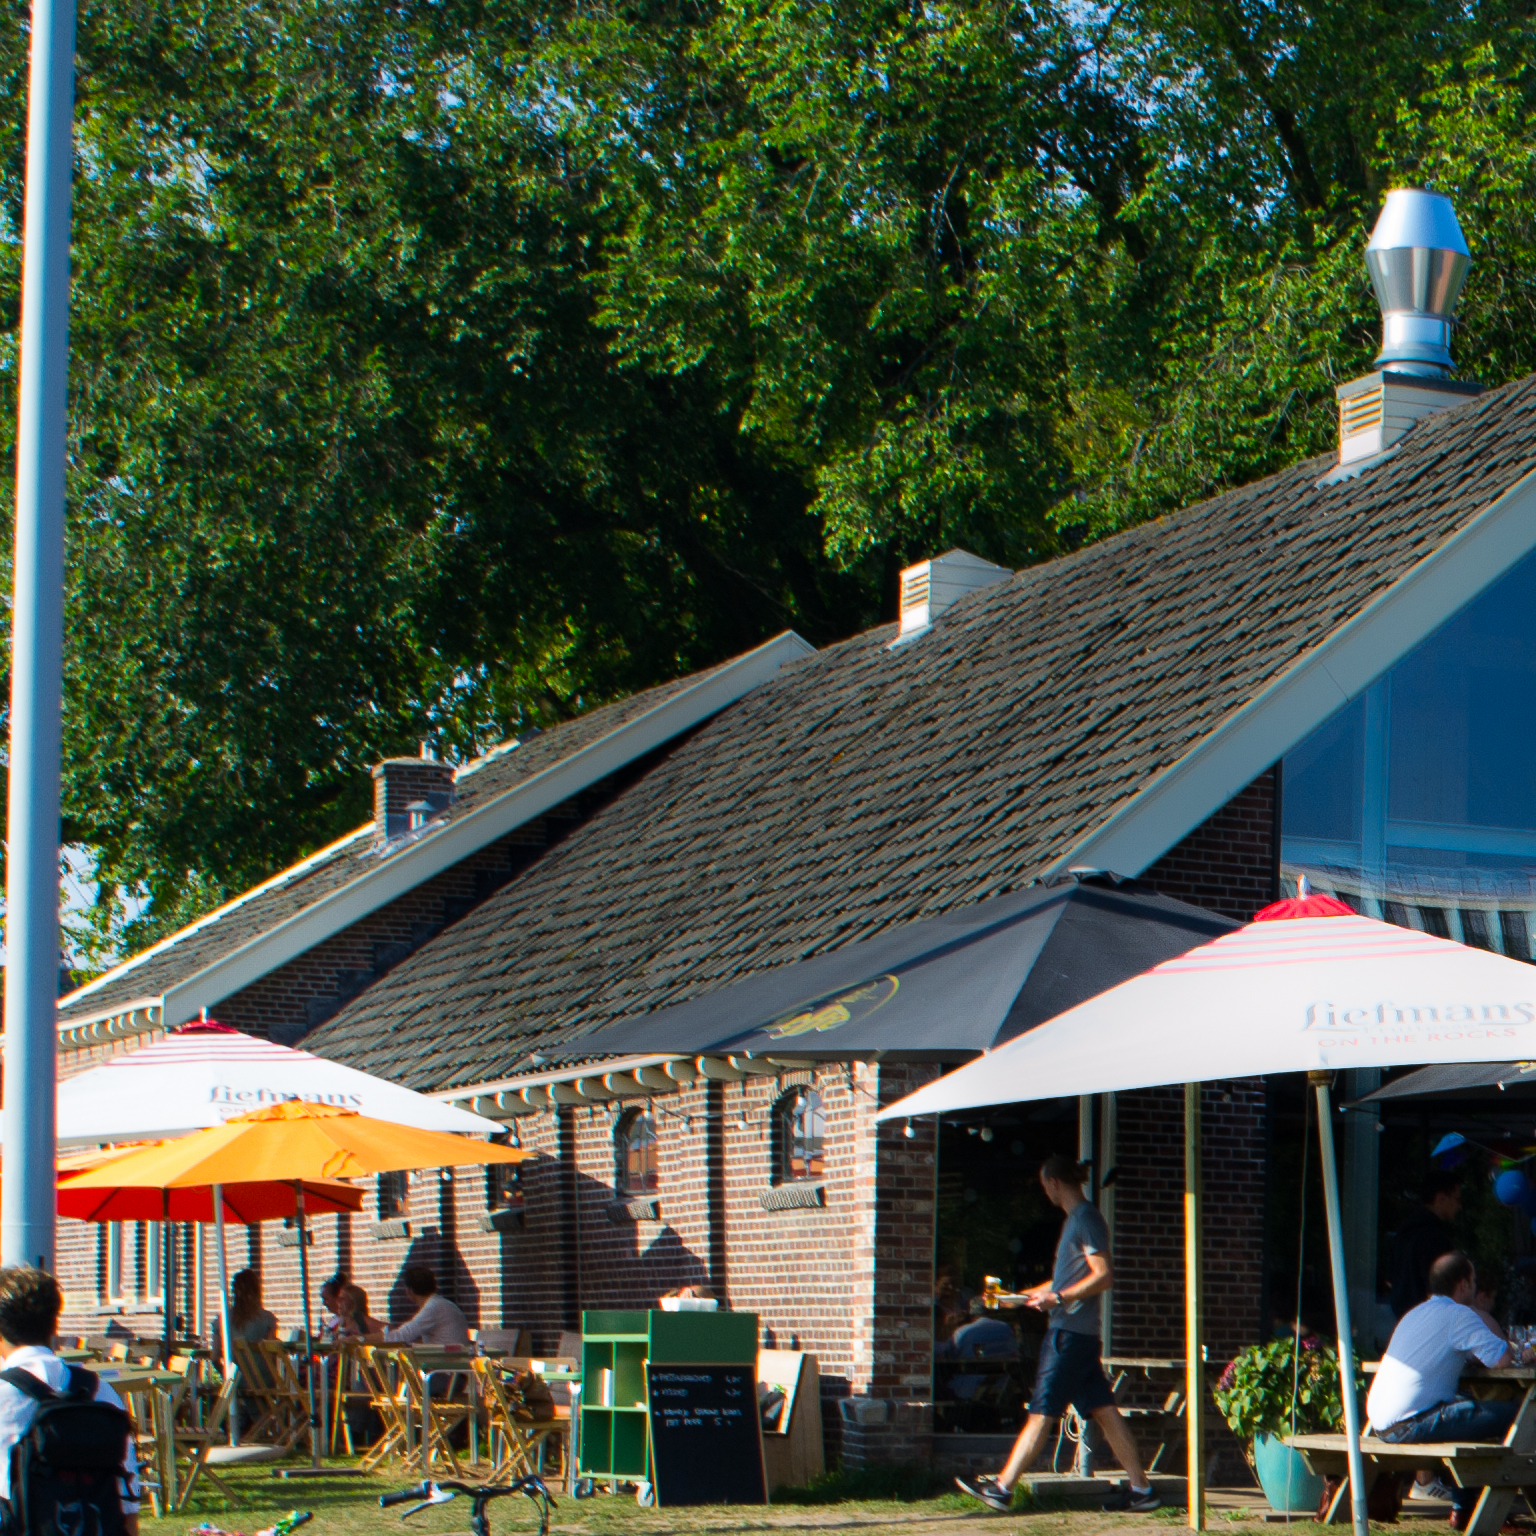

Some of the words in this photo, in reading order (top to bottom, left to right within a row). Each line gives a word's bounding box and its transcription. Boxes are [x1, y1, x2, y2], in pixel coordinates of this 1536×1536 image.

[1300, 1000, 1536, 1033] Liefmans
[1318, 1037, 1359, 1048] ON
[1371, 1034, 1418, 1045] THE
[1427, 1027, 1518, 1043] ROCKS
